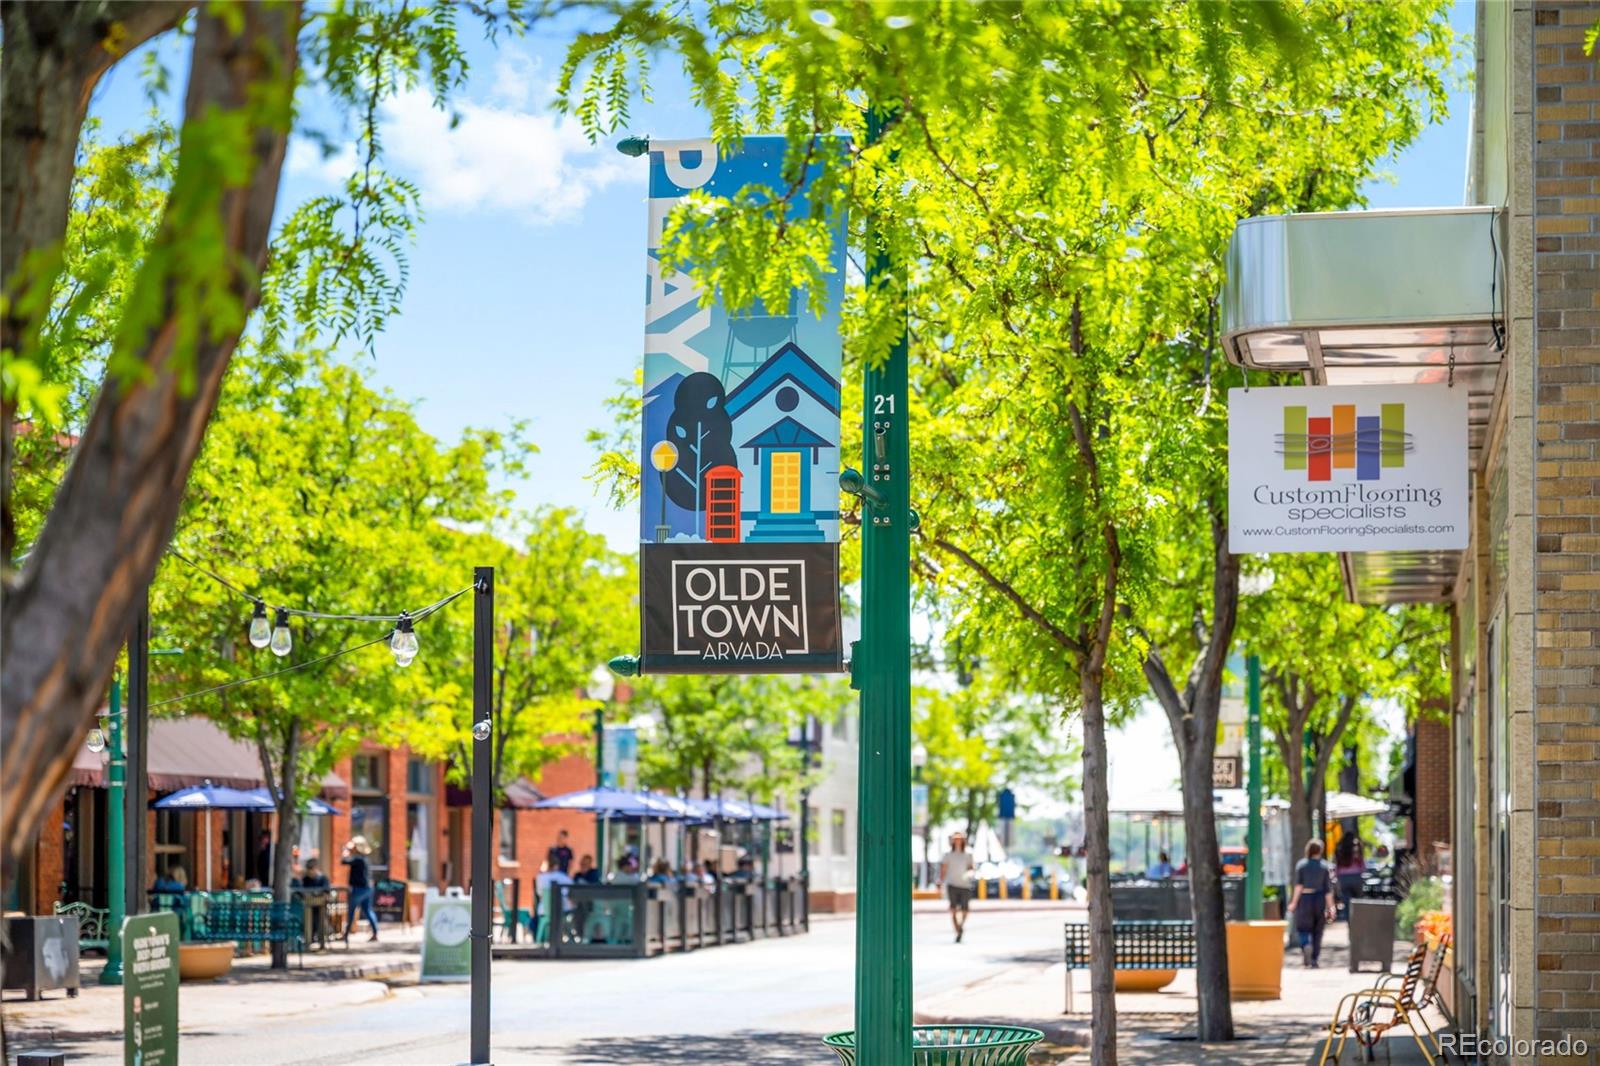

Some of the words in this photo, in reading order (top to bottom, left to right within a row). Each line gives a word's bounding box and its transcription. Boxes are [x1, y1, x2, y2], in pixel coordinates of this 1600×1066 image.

[874, 394, 895, 415] 21
[1288, 504, 1406, 523] specialists
[1242, 524, 1455, 537] www.CustomFlooringSpecialists.com
[685, 567, 791, 602] OLDE
[678, 604, 800, 638] TOWN
[702, 641, 784, 660] ARVADA
